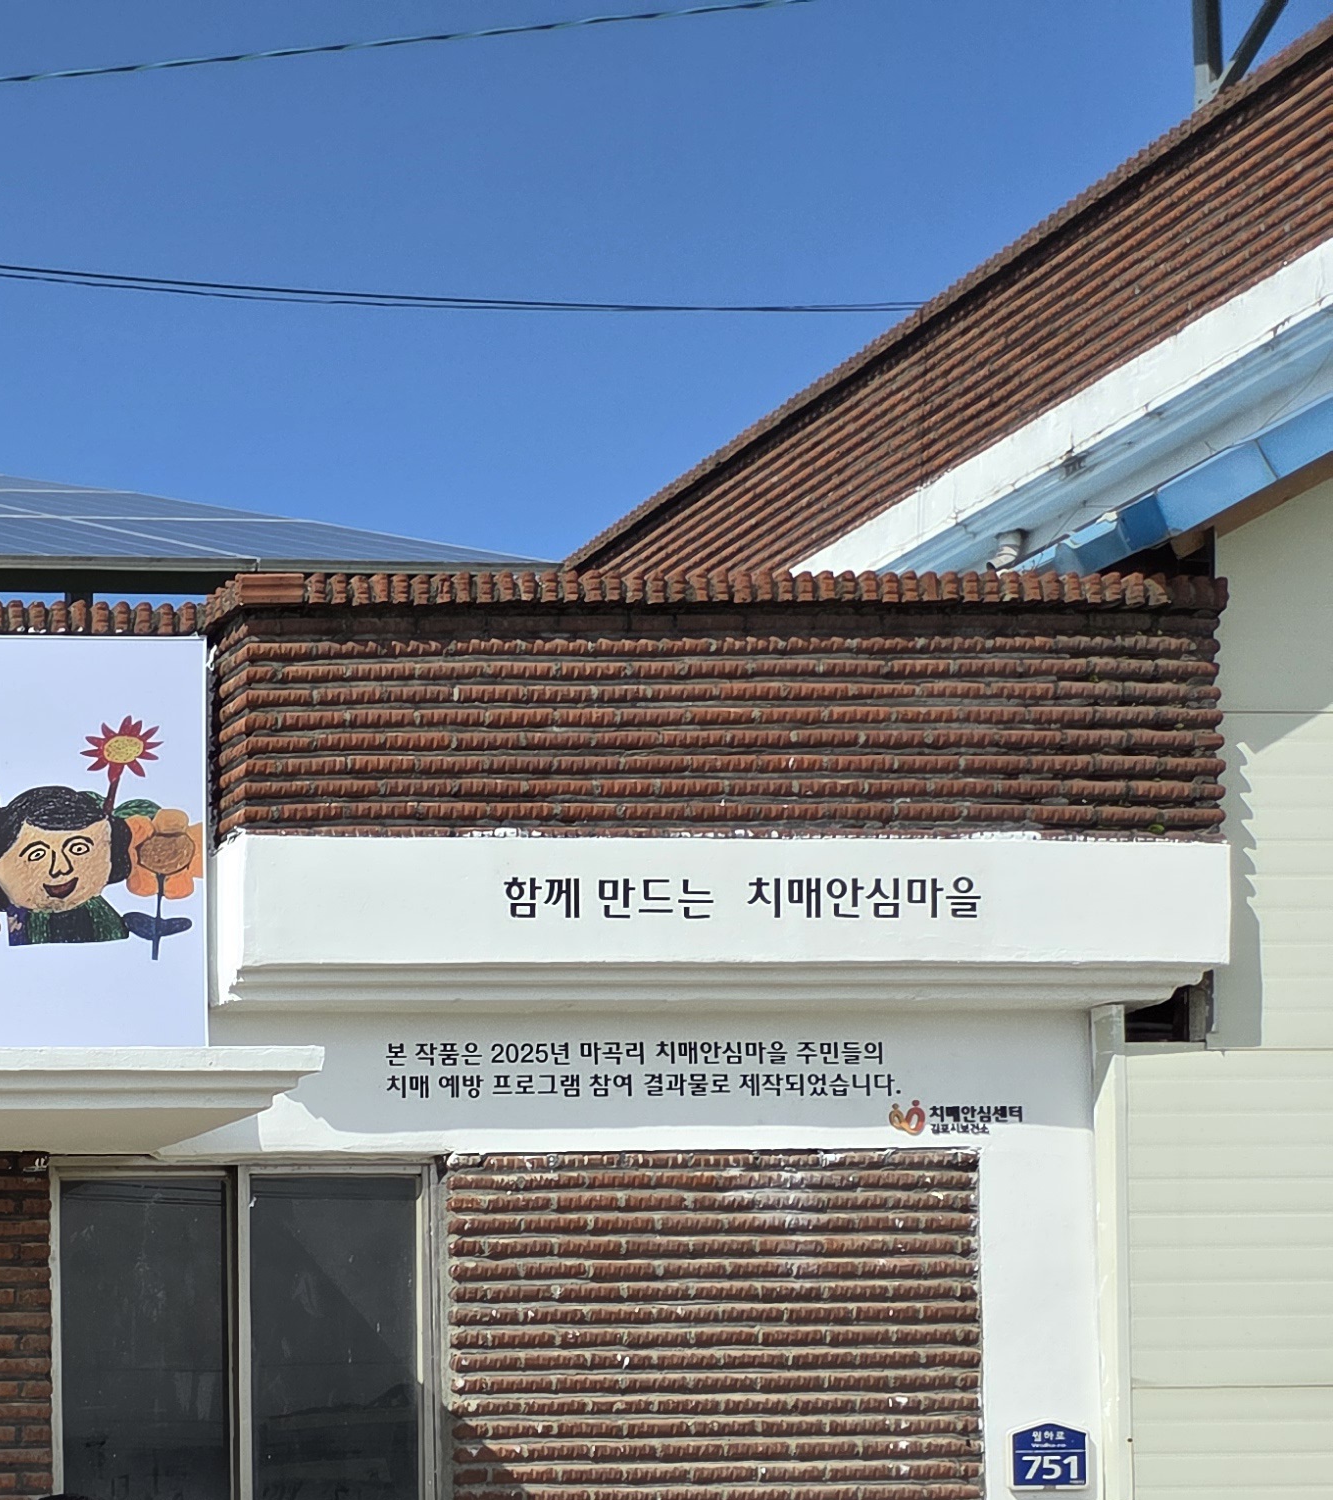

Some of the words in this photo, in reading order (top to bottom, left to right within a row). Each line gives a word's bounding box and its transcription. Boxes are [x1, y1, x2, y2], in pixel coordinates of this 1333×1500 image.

[503, 876, 580, 919] 함께
[598, 878, 714, 919] 만드는
[747, 876, 982, 919] 치매안심마을
[385, 1042, 408, 1067] 본
[414, 1042, 483, 1067] 작품은
[490, 1041, 571, 1066] 2025년
[579, 1041, 645, 1066] 마곡리
[655, 1040, 788, 1065] 치매안심마을
[796, 1041, 883, 1065] 주민들의
[386, 1075, 430, 1099] 치매
[438, 1074, 485, 1099] 예방
[492, 1074, 580, 1098] 프로그램
[589, 1073, 633, 1098] 참여
[644, 1073, 731, 1097] 결과물로
[738, 1073, 901, 1097] 제작되었습니다.
[929, 1105, 1023, 1123] 치매안심센터
[930, 1123, 990, 1135] 김포시보건소
[1021, 1455, 1079, 1480] 751
